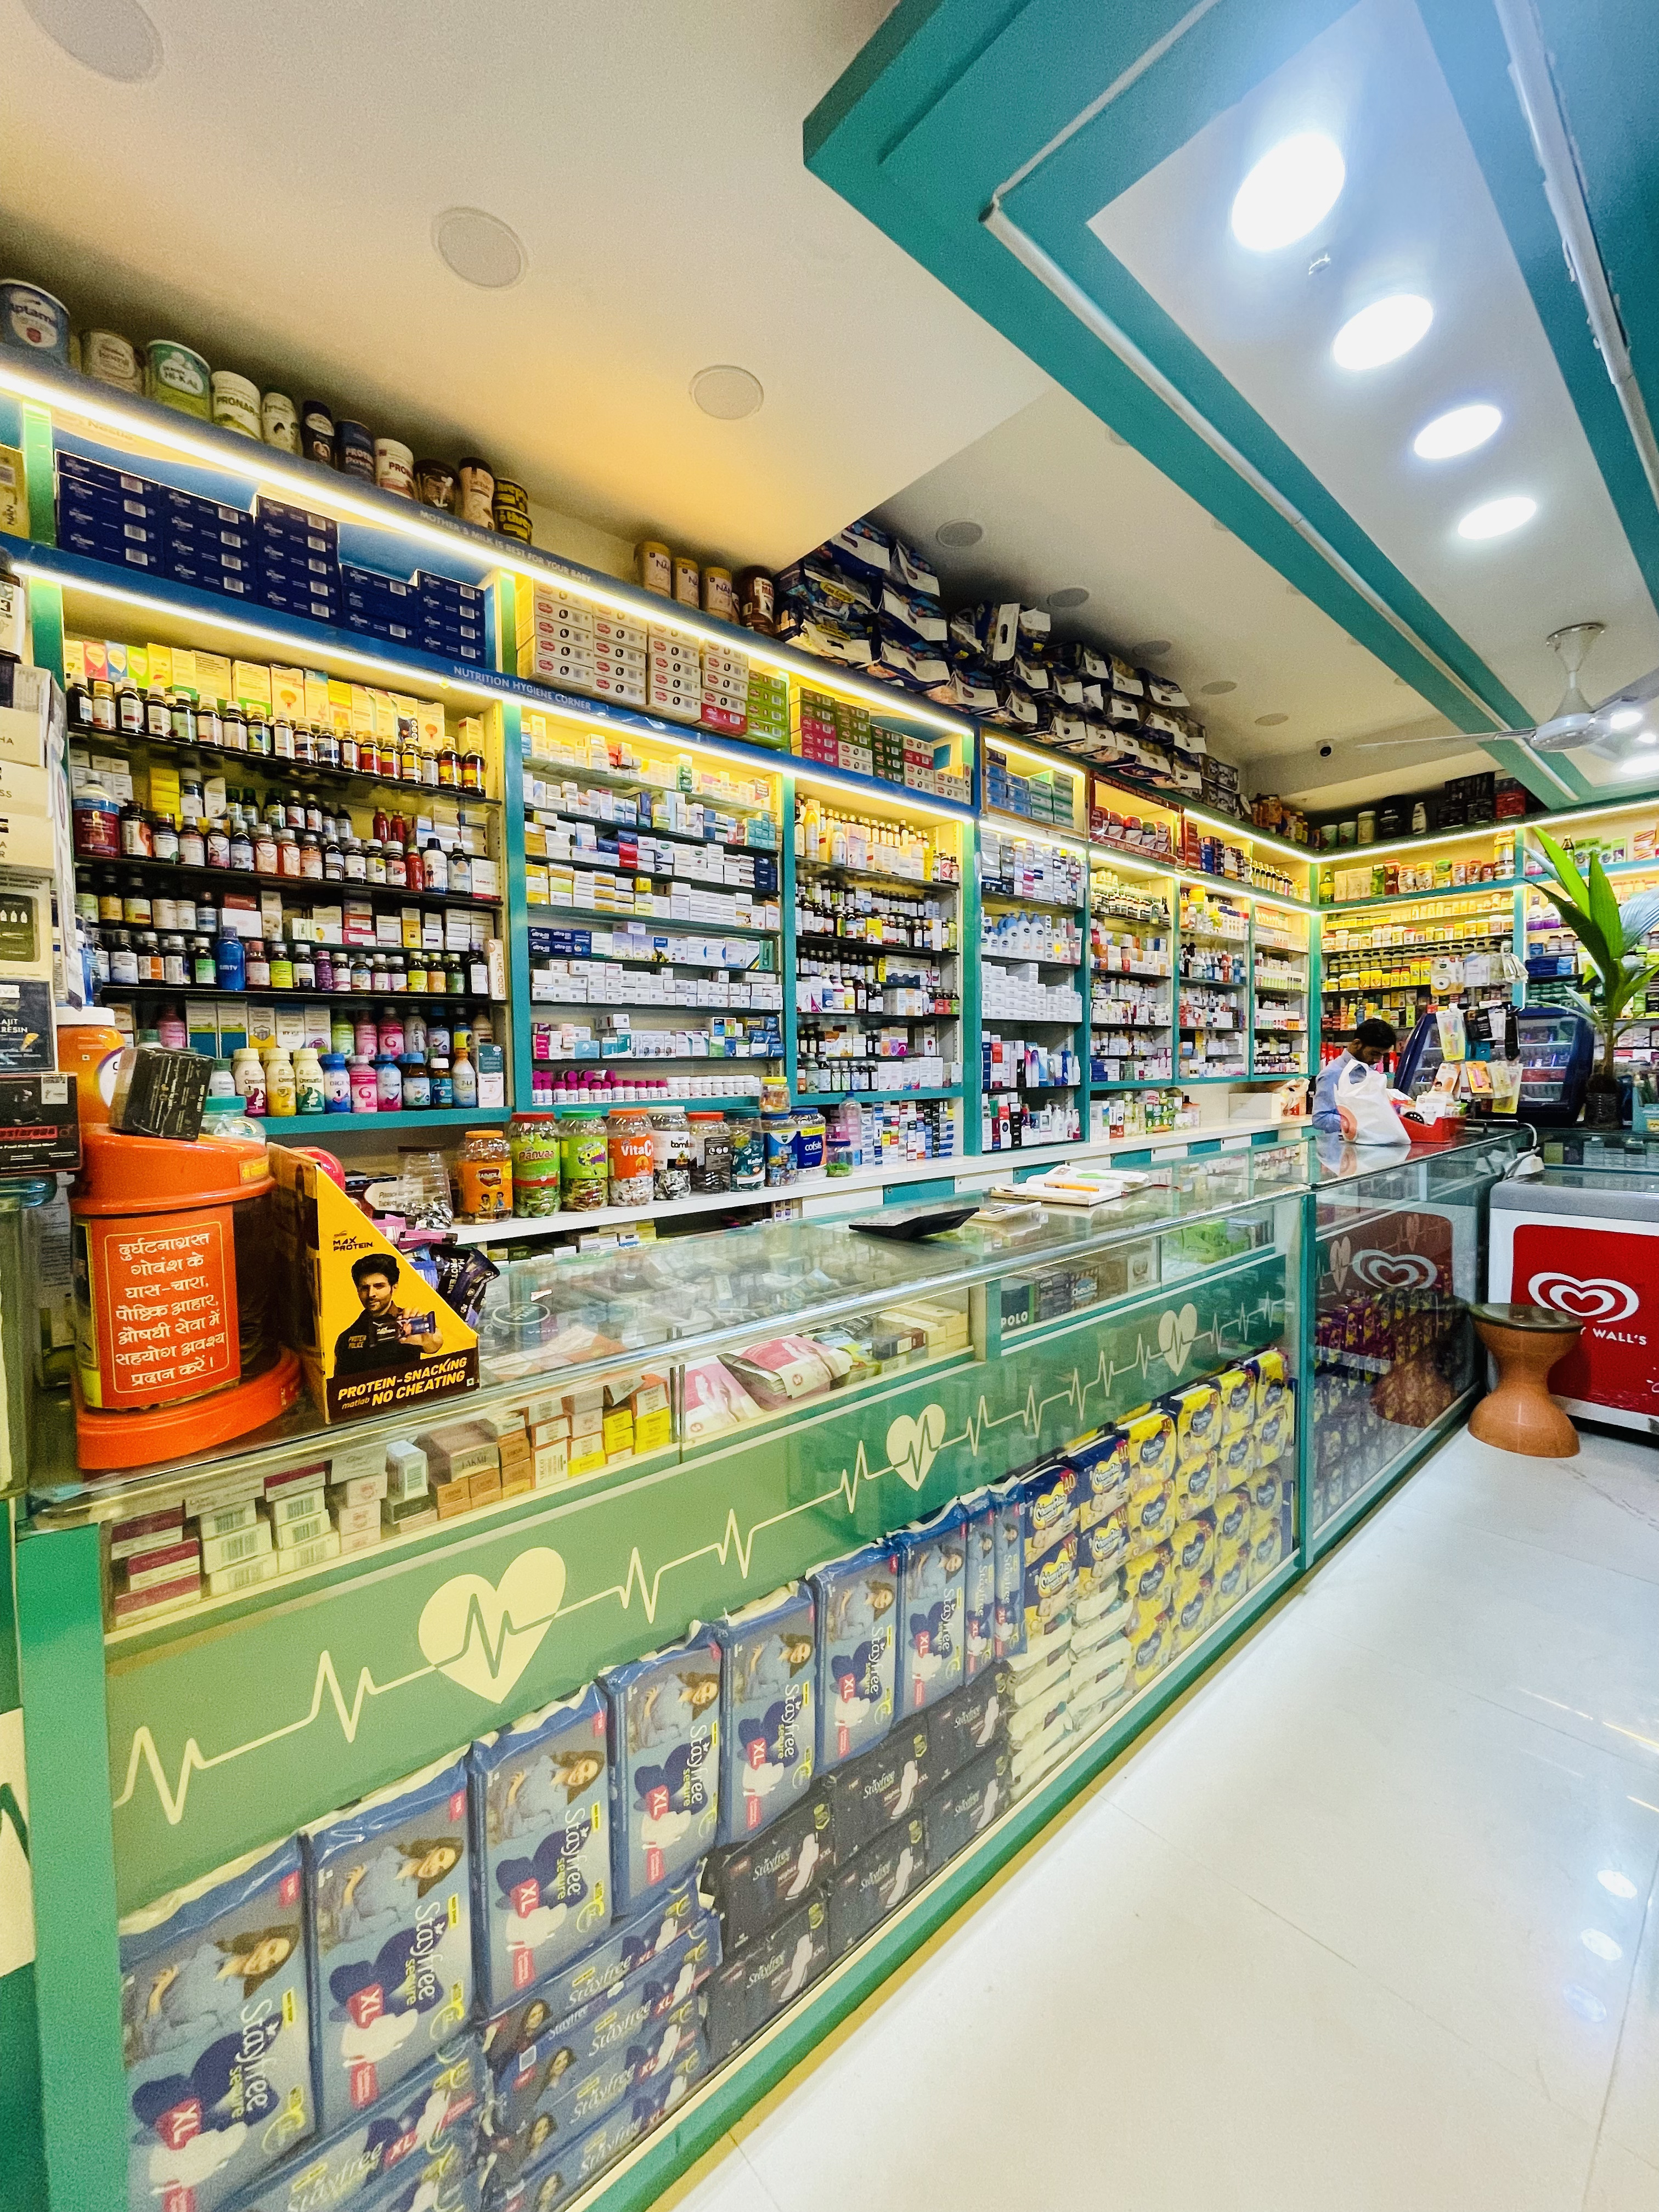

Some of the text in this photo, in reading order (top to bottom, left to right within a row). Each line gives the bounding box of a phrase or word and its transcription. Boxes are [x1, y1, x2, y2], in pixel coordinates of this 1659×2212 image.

[527, 549, 545, 565] FOR
[546, 557, 569, 574] YOUR
[454, 665, 591, 712] NUTRITION HYGIENE CORNER
[333, 1235, 357, 1246] MAX
[333, 1242, 374, 1252] PROTEIN
[186, 1251, 205, 1267] के
[175, 1317, 206, 1334] सेवा
[208, 1308, 221, 1327] में
[1000, 1311, 1028, 1329] POLO
[1592, 1328, 1647, 1345] WALL'S
[115, 1331, 225, 1366] सहयोग अवश्य
[131, 1367, 176, 1387] प्रदान
[342, 1370, 466, 1410] matlab NO CHEATING
[941, 1588, 955, 1650] Stayfree
[868, 1626, 884, 1694] Stayfree
[919, 1635, 929, 1655] XL
[844, 1678, 854, 1698] XL
[781, 1684, 800, 1758] Stayfree
[686, 1724, 708, 1805] Stayfree
[753, 1741, 765, 1765] XL
[653, 1790, 667, 1815] XL
[561, 1807, 588, 1895] Stayfree
[753, 1847, 792, 1881] Stayfree
[556, 1857, 566, 1900] secure
[520, 1882, 537, 1914] XL
[410, 1901, 443, 2002] Stayfree
[569, 1955, 633, 2006] Stayfree
[360, 1988, 381, 2023] XL
[658, 1996, 672, 2010] XL
[588, 2000, 652, 2057] Stayfree
[235, 1997, 273, 2112] Stayfree
[641, 2060, 656, 2074] XL
[574, 2063, 635, 2117] Stayfree
[173, 2104, 198, 2145] XL
[390, 2135, 413, 2160] XL
